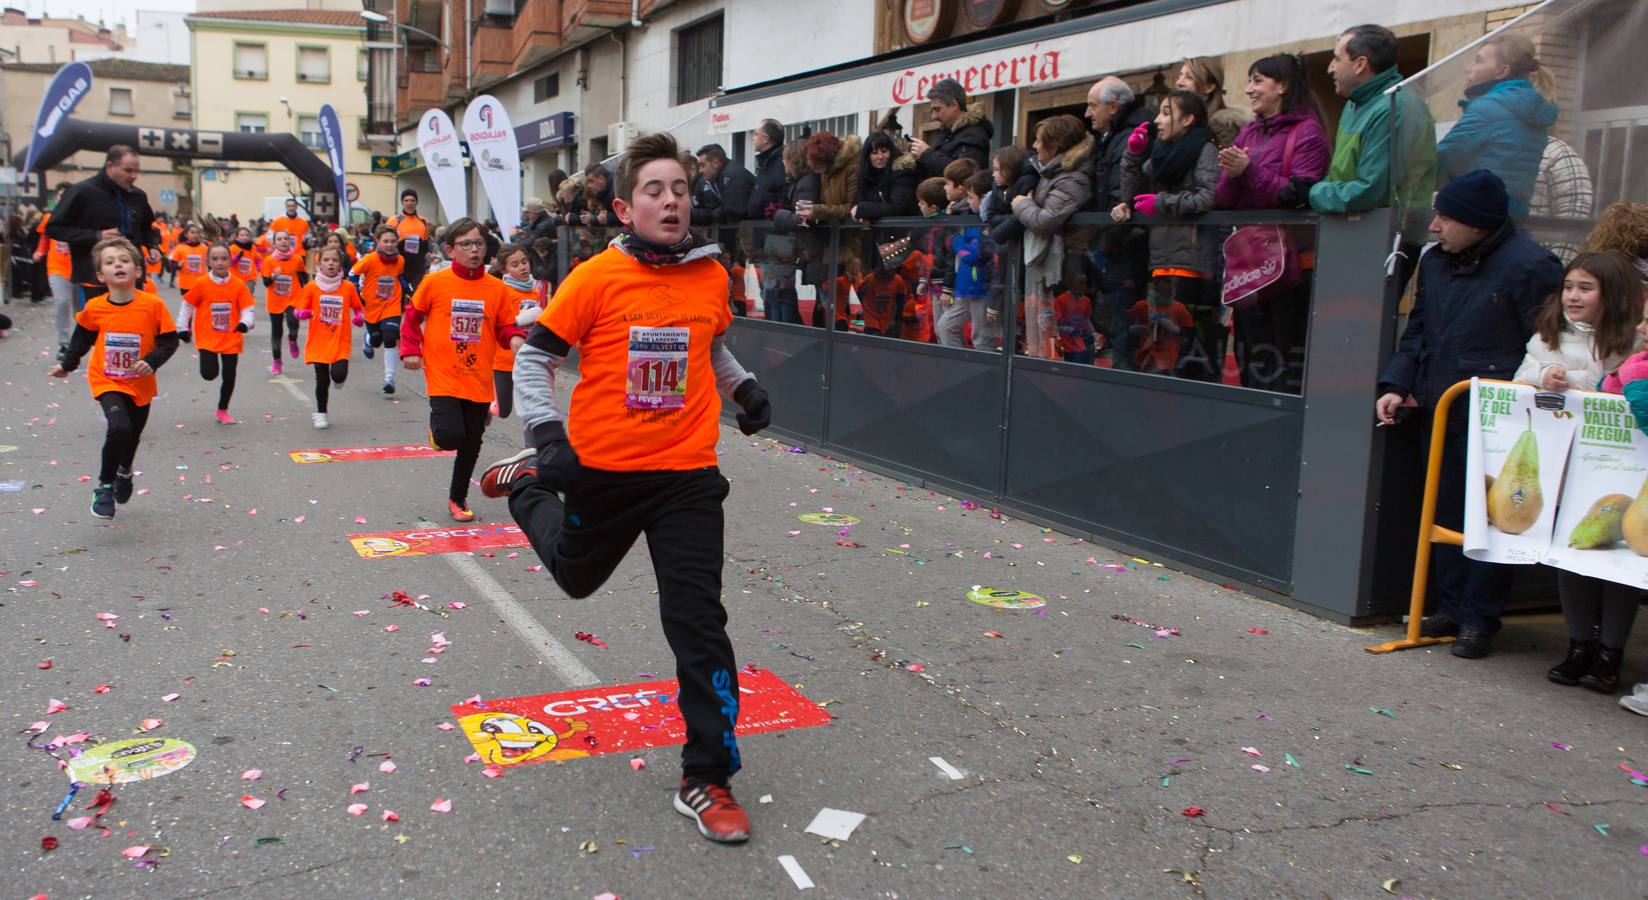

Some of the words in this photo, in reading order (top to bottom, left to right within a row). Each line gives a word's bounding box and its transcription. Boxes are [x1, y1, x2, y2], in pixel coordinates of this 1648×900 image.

[1224, 269, 1261, 293] adidas
[456, 317, 478, 333] 573
[112, 352, 131, 369] 48
[638, 360, 679, 392] 114
[1498, 388, 1517, 401] DEL
[1492, 401, 1511, 415] DEL
[1584, 397, 1625, 413] PERAS
[1584, 411, 1621, 428] VALLE
[1581, 425, 1632, 443] IREGUA
[406, 526, 521, 540] GREFS
